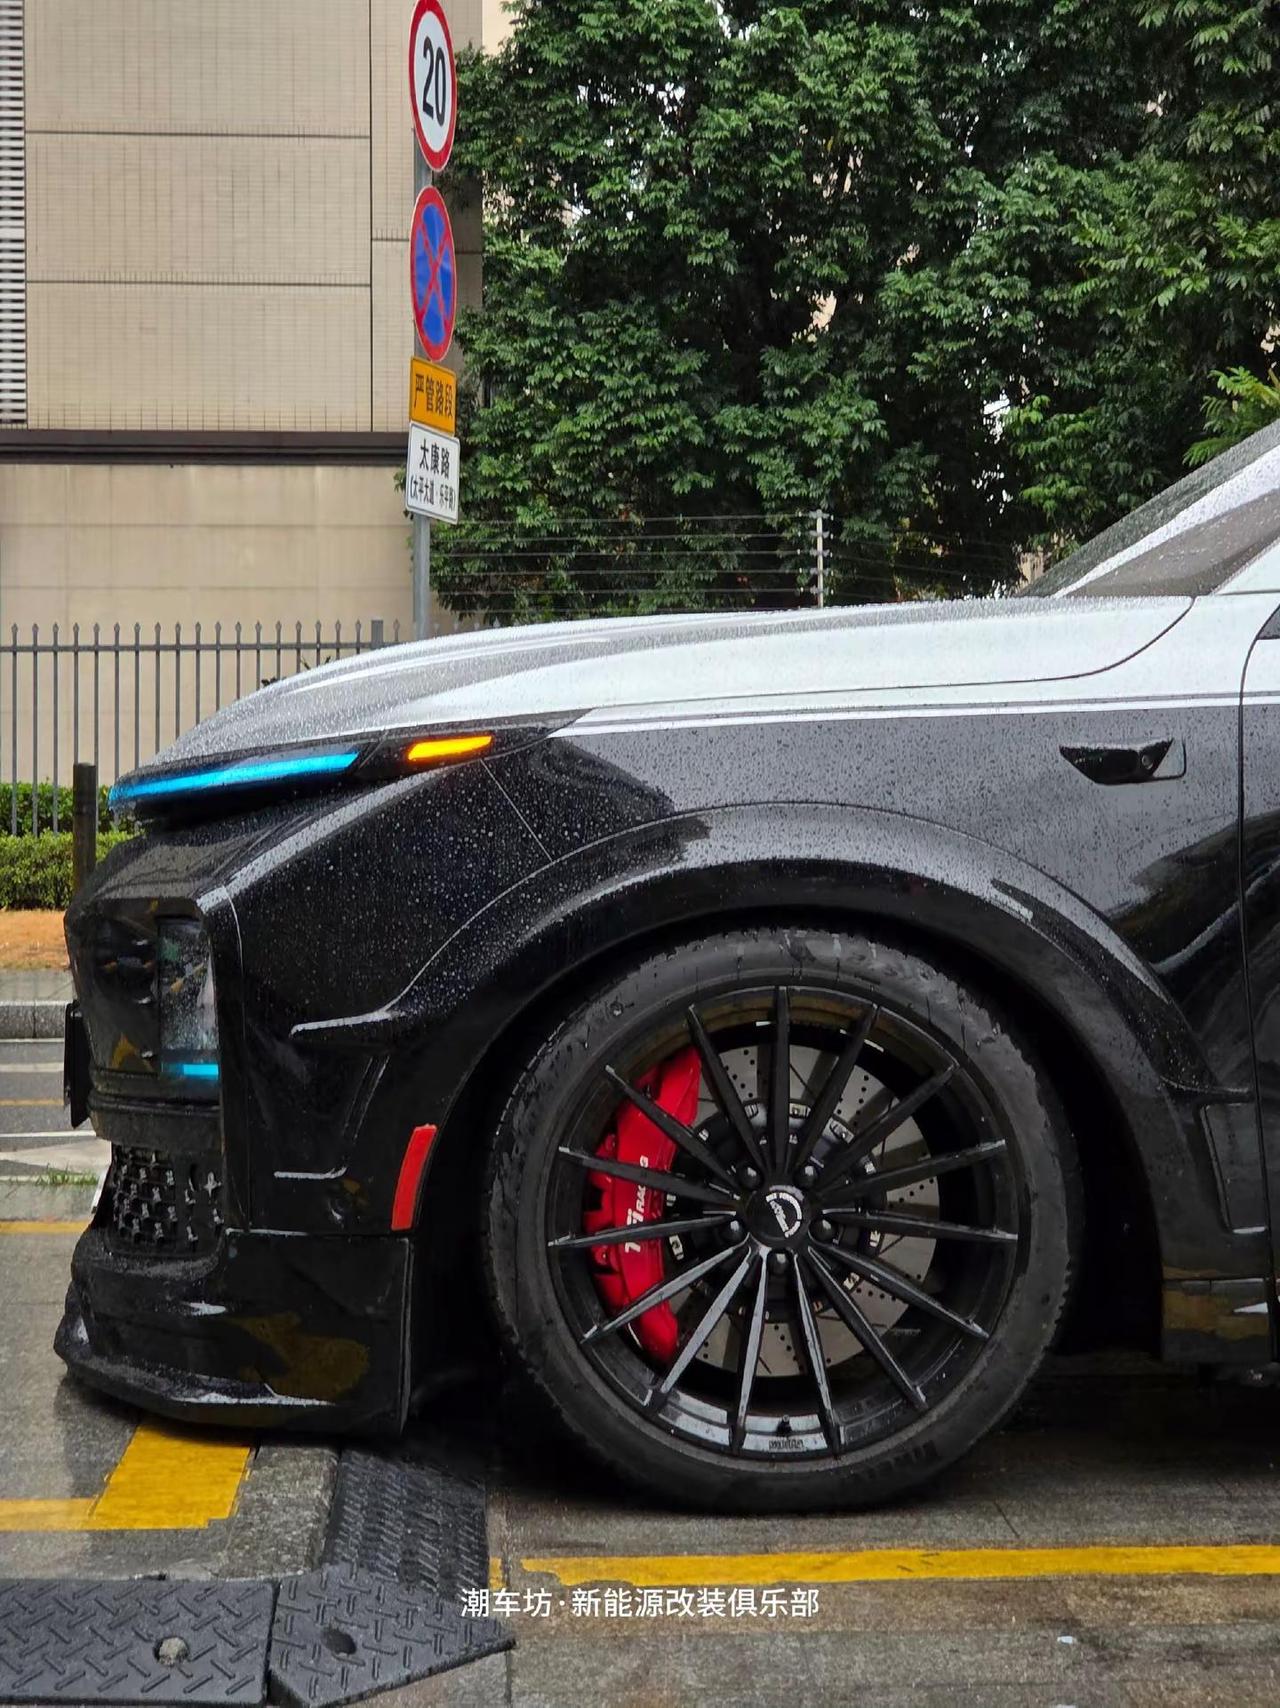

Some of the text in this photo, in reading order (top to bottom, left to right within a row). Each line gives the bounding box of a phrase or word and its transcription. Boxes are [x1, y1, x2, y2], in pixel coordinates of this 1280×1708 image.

[422, 36, 446, 127] 20
[414, 373, 453, 418] 严管路段
[420, 438, 450, 480] 太康路
